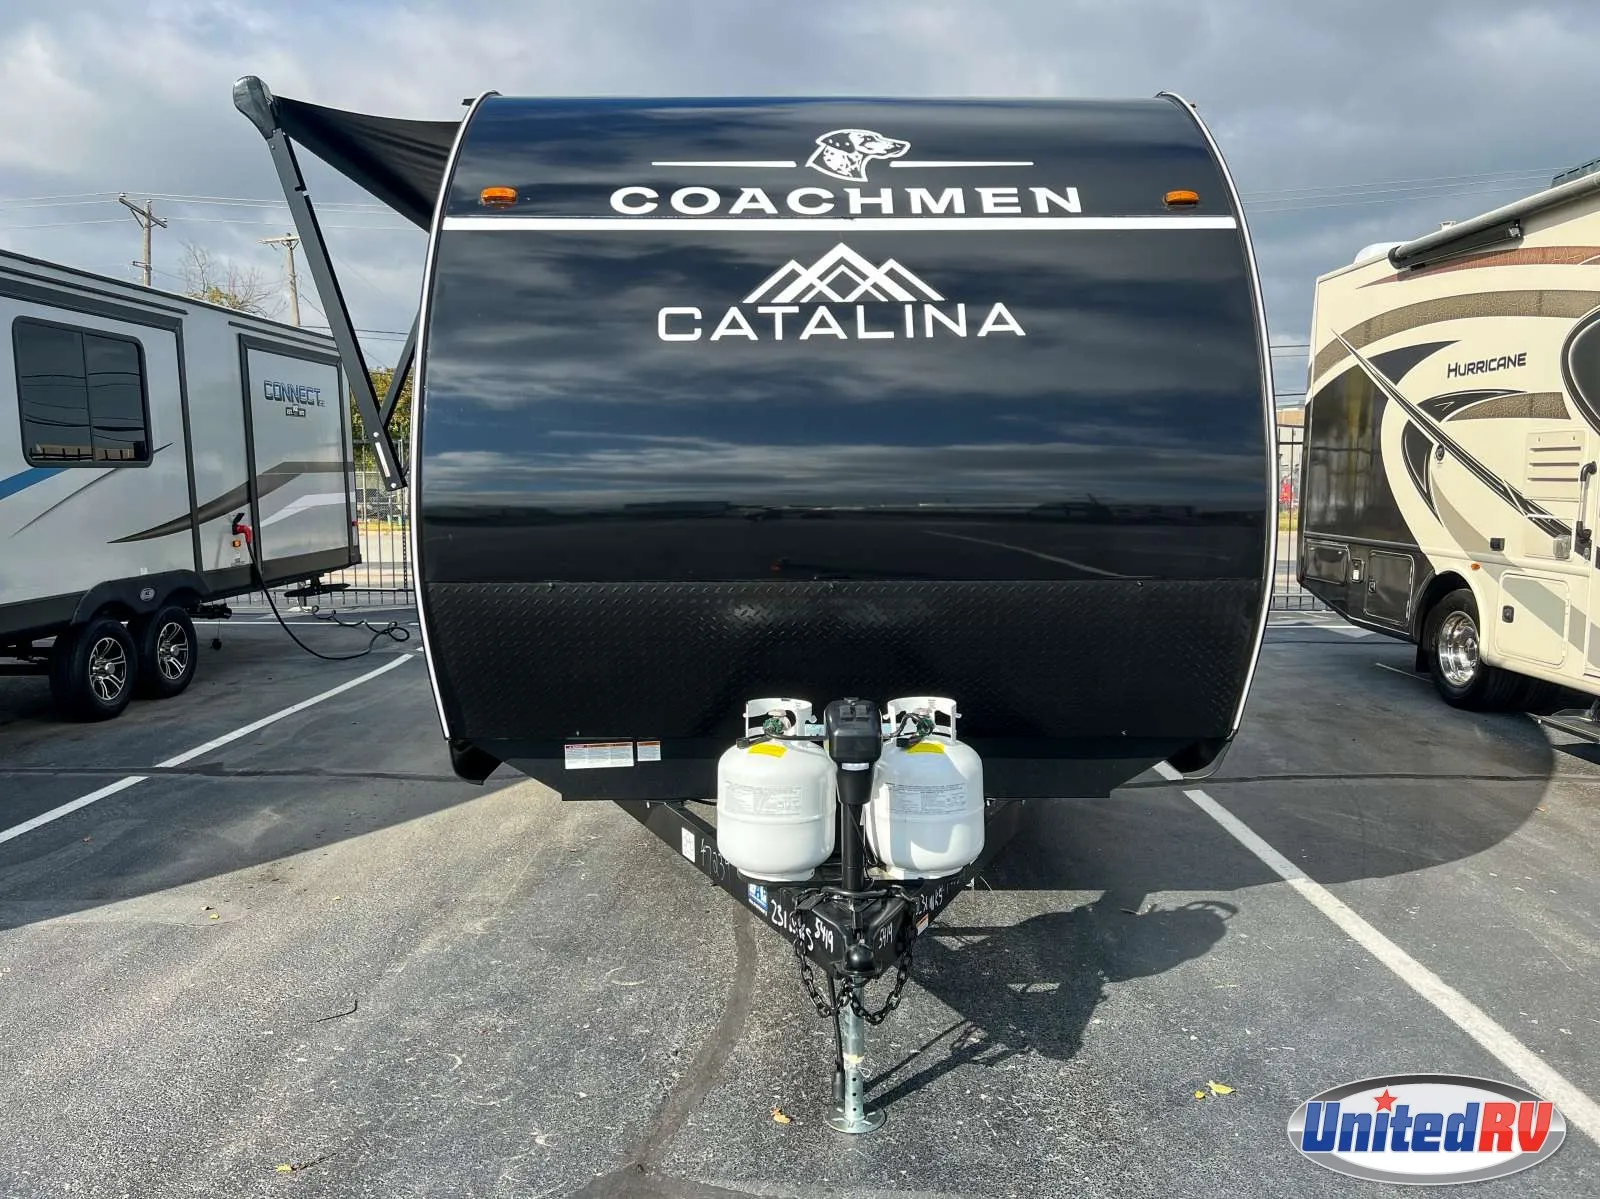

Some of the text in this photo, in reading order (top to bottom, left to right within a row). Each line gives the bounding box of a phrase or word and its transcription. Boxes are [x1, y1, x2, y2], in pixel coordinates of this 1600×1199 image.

[609, 186, 1082, 215] COACHMEN
[657, 302, 1026, 341] CATALINA
[1446, 352, 1528, 378] HURRICANE
[263, 380, 321, 407] CONNECT
